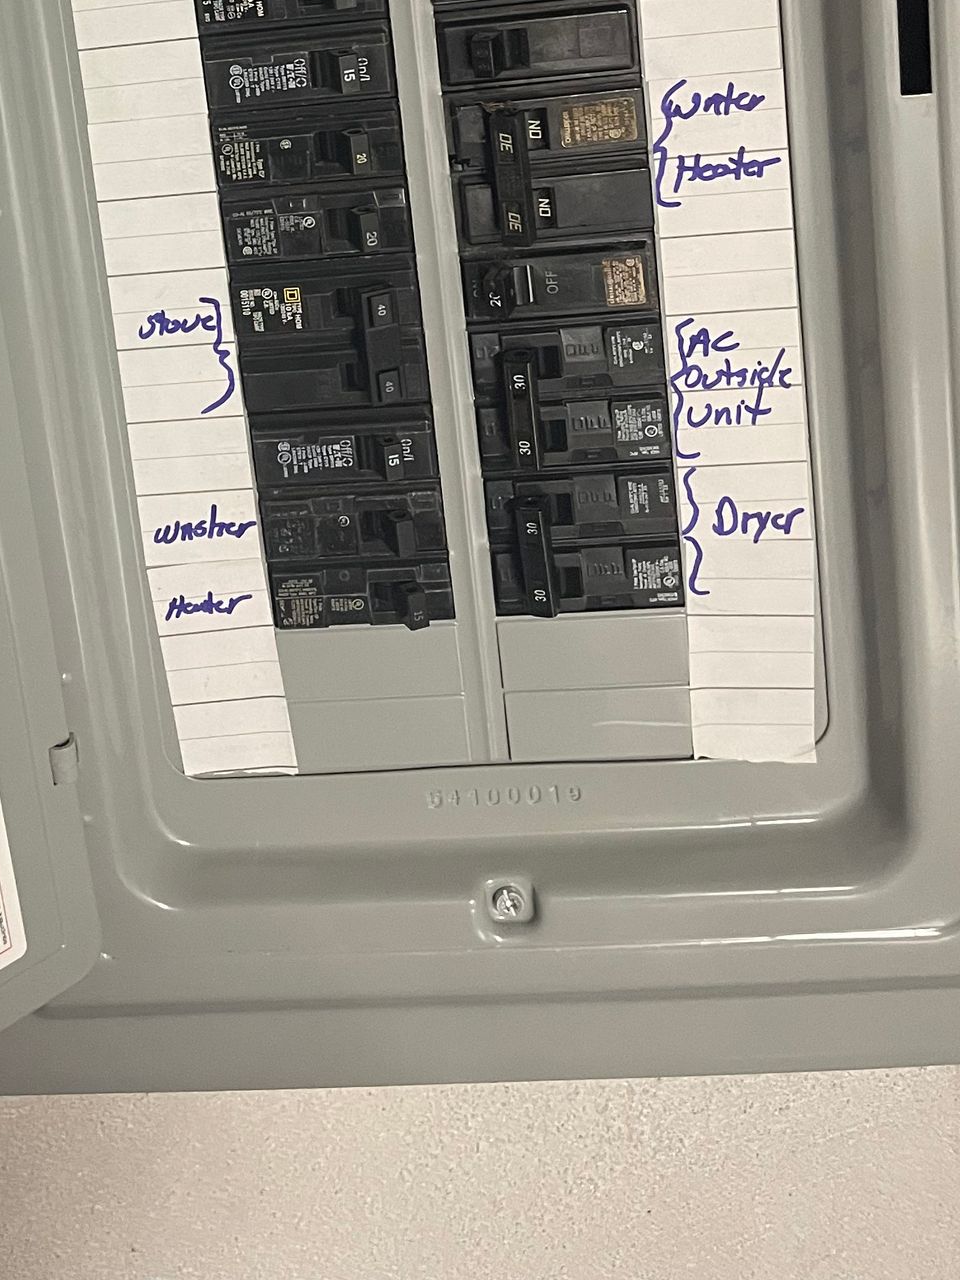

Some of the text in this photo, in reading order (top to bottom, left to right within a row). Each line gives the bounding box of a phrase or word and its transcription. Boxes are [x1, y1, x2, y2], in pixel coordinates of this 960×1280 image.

[255, 1, 264, 17] HOM
[344, 69, 355, 81] 15
[528, 120, 542, 139] ON
[498, 133, 514, 154] 30
[356, 153, 367, 164] 20
[674, 146, 782, 193] Heater
[538, 198, 552, 217] ON
[508, 212, 522, 232] 30
[367, 232, 377, 246] 20
[544, 271, 559, 294] OFF
[240, 290, 251, 315] 0015110
[378, 304, 386, 315] 40
[685, 328, 740, 357] AC
[684, 347, 793, 390] Outside
[385, 382, 394, 392] 40
[514, 374, 525, 390] 30
[519, 440, 531, 456] 30
[389, 454, 400, 466] 15
[527, 522, 538, 534] 30
[712, 496, 805, 544] Dryer
[534, 590, 547, 602] 30
[165, 591, 252, 621] Heater
[414, 611, 424, 621] 15
